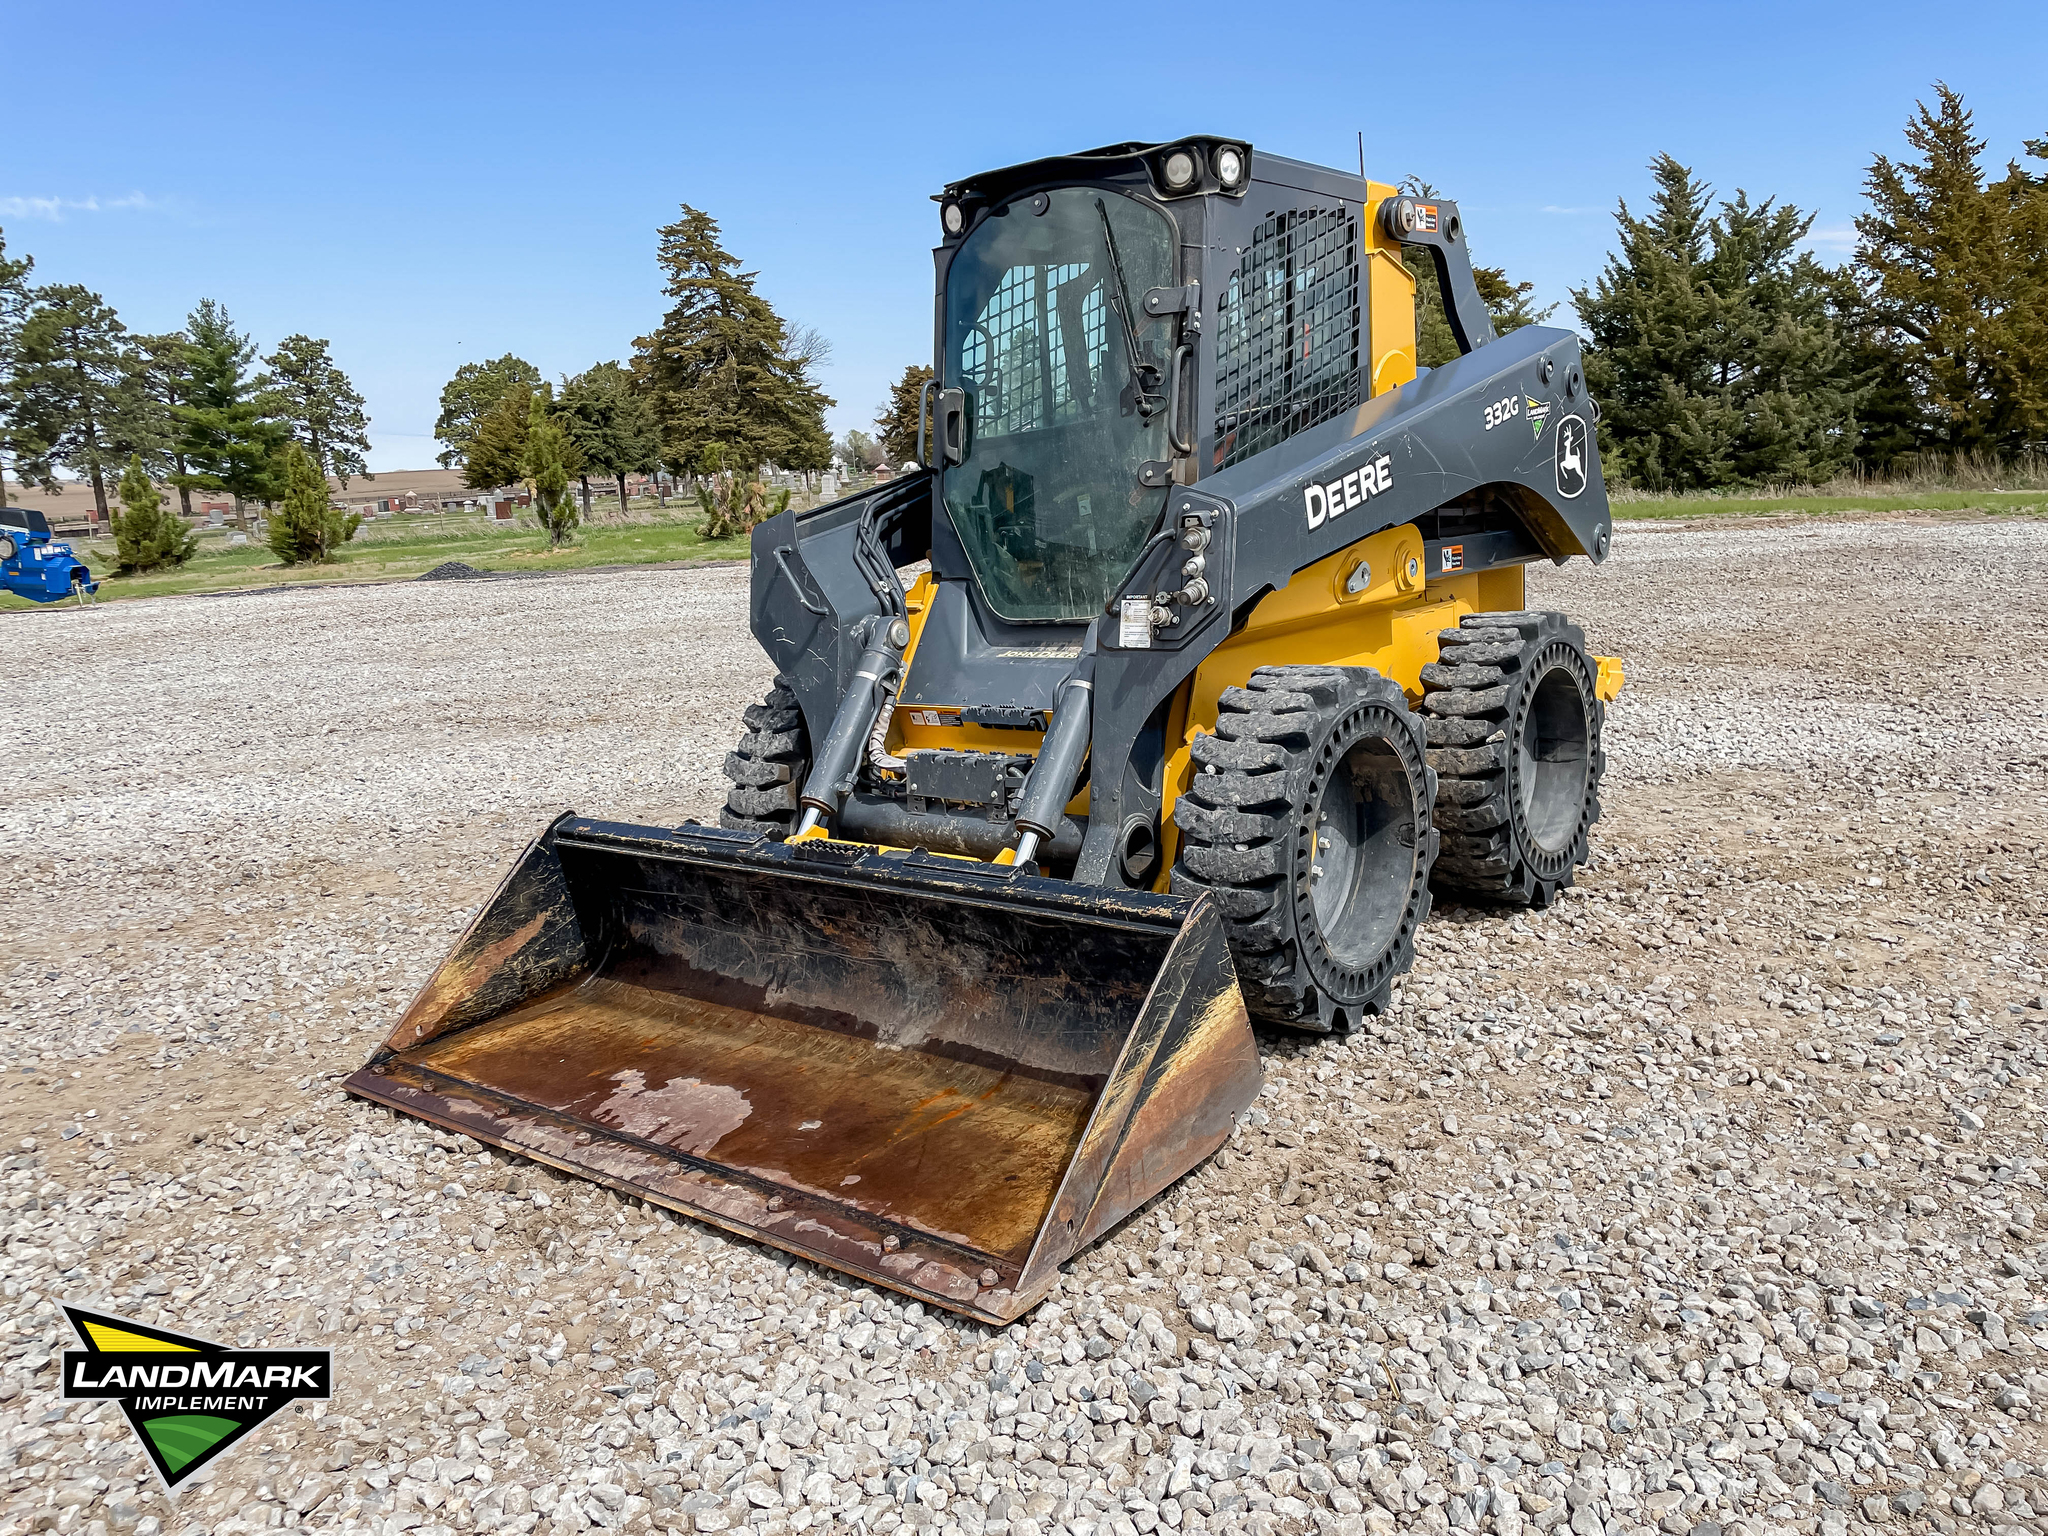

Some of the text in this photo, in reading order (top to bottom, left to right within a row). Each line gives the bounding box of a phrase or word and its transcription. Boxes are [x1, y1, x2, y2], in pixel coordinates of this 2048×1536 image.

[1484, 395, 1519, 431] 332G
[1303, 454, 1393, 530] DEERE
[996, 650, 1080, 659] JOHN DEER
